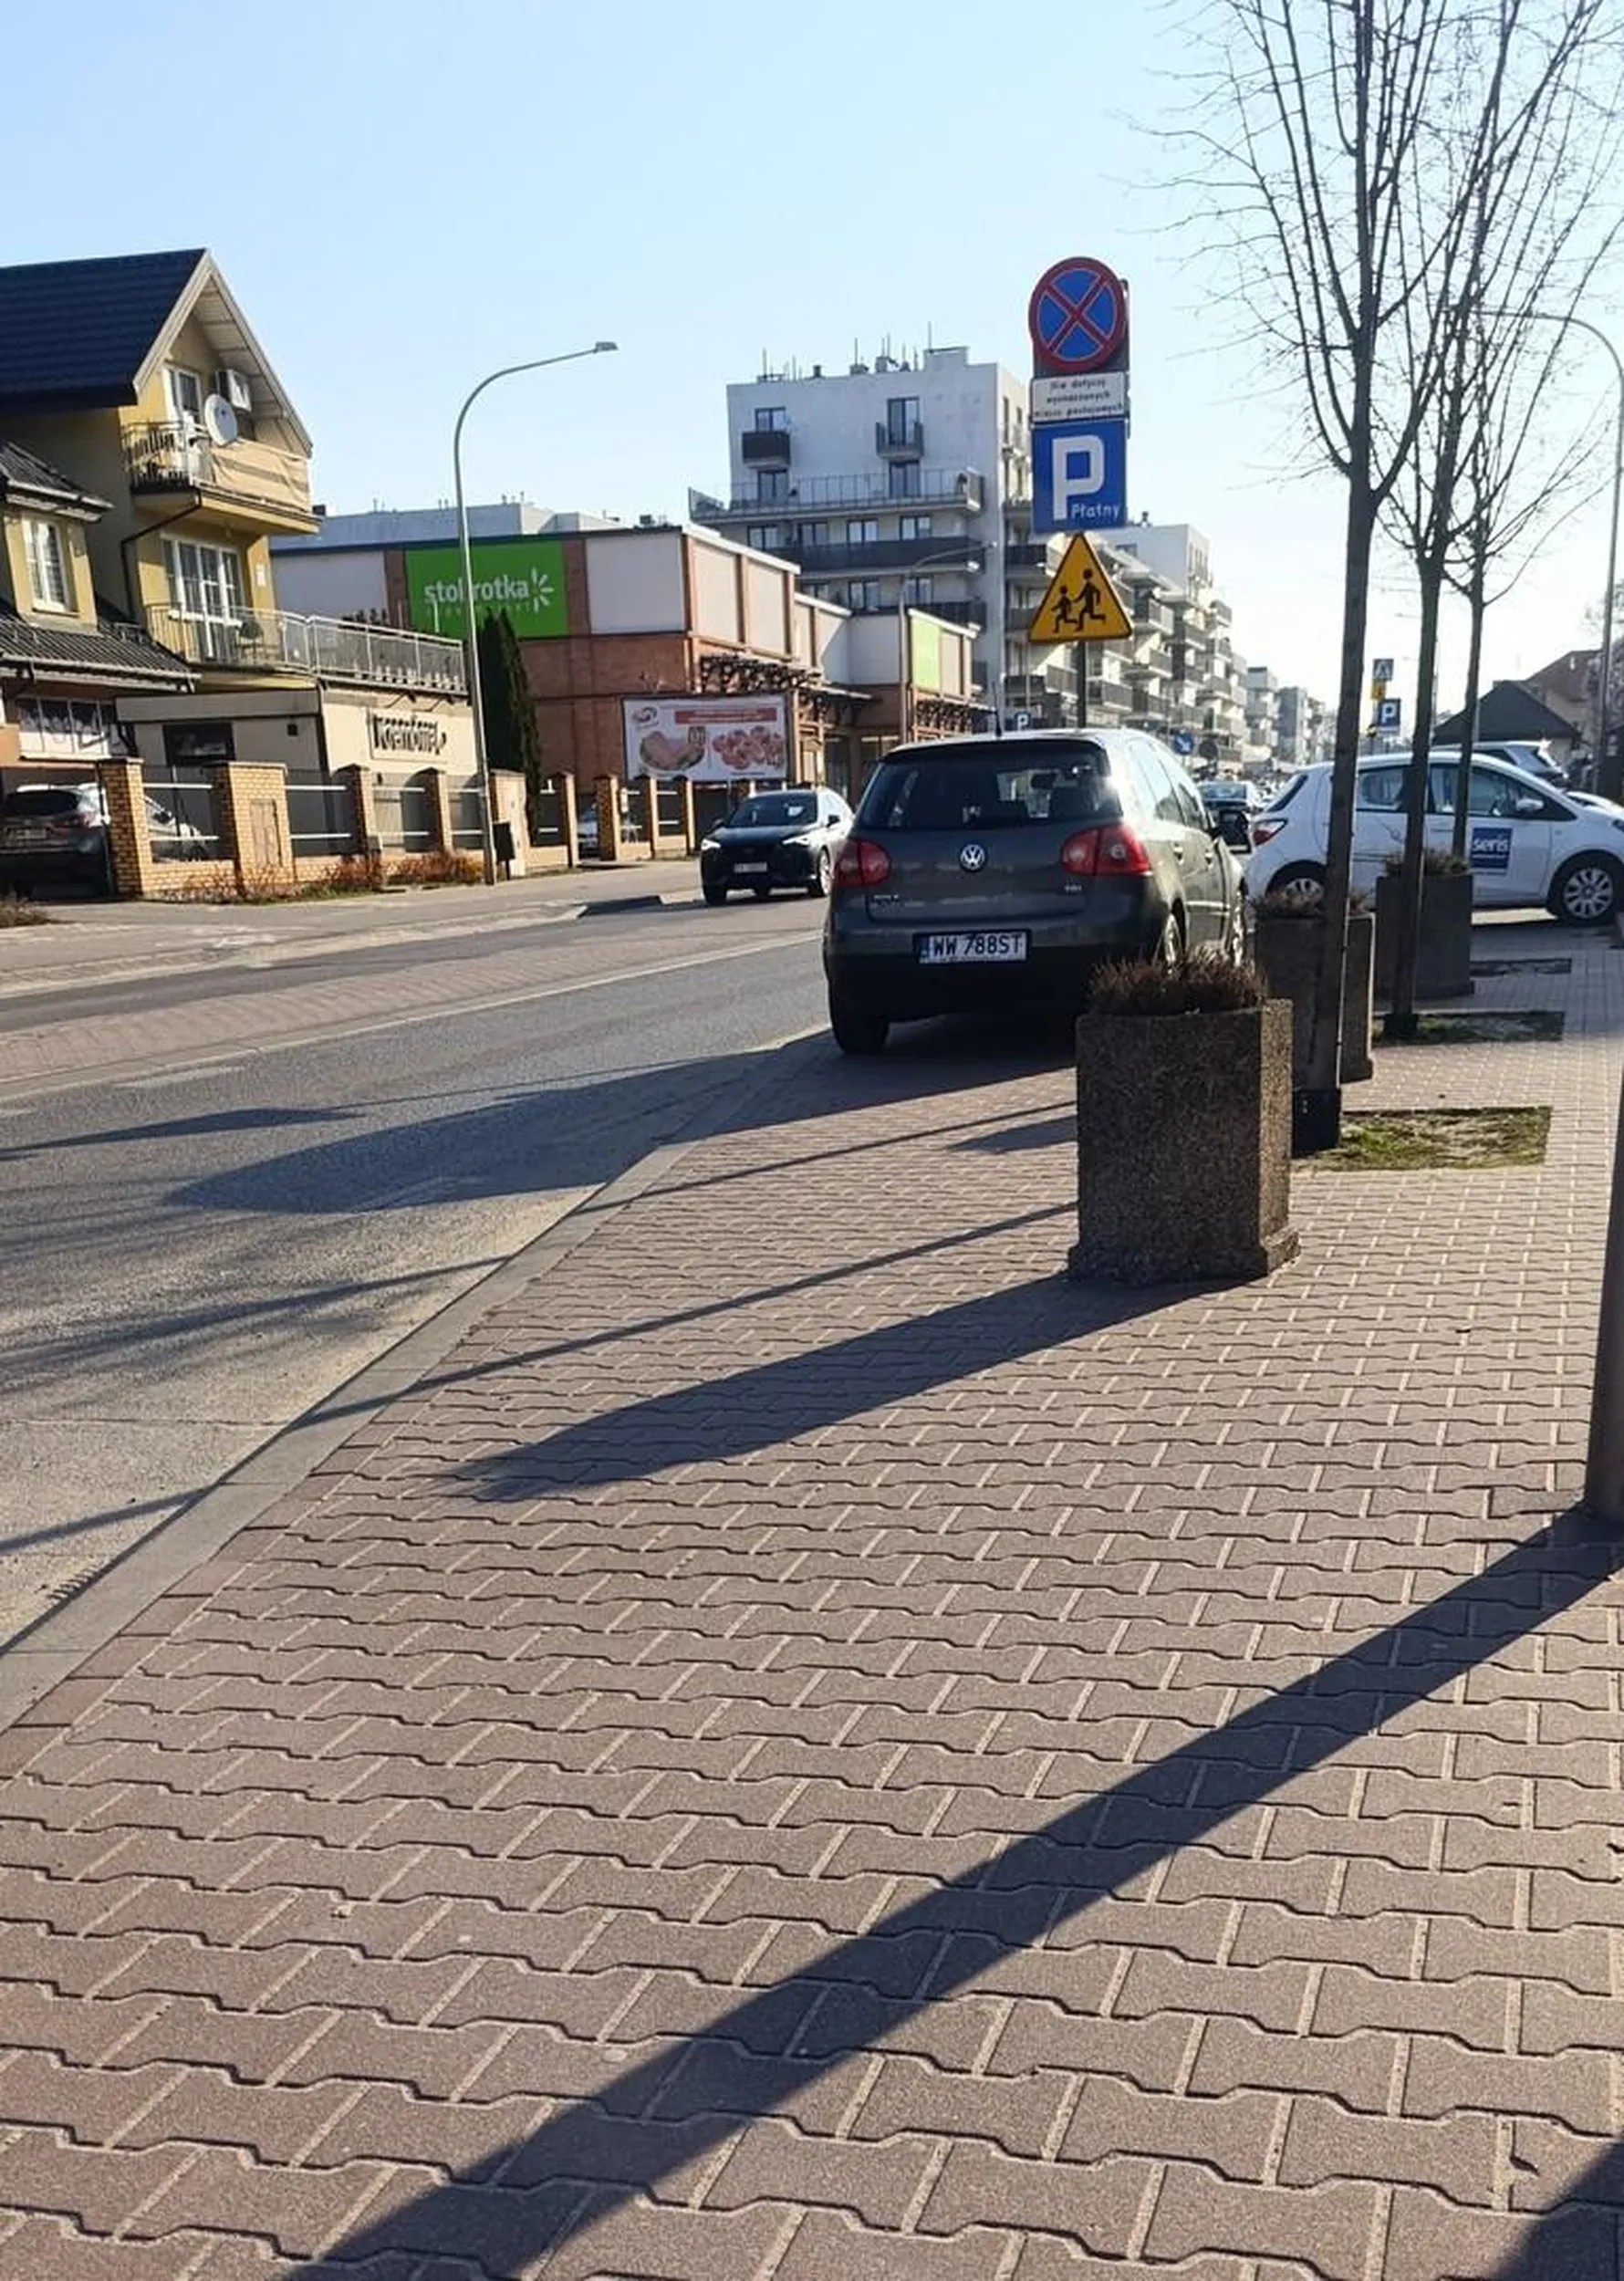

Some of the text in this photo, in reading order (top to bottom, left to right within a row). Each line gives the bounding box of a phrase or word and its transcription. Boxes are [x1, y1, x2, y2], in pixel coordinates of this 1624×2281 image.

[1052, 434, 1104, 521] P
[1071, 503, 1120, 522] Płatny
[1017, 713, 1028, 730] P
[1381, 703, 1397, 724] P
[933, 932, 1020, 956] WW 788ST
